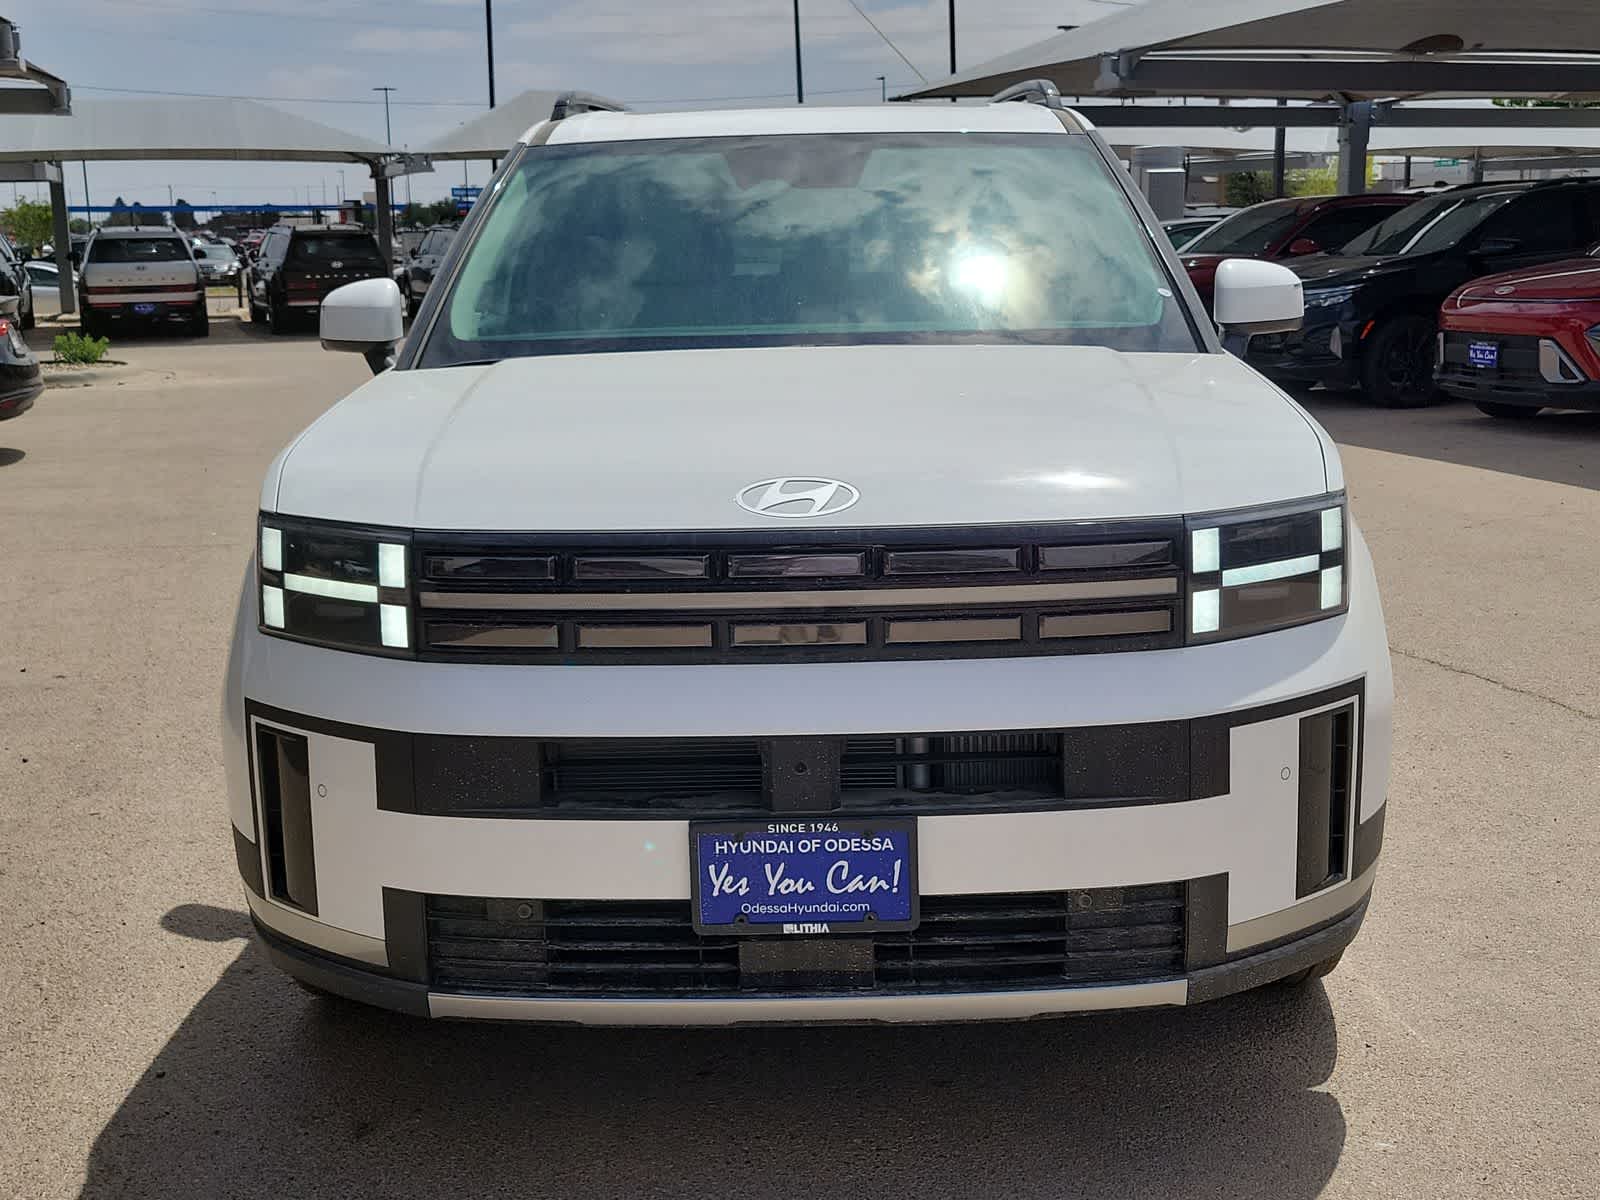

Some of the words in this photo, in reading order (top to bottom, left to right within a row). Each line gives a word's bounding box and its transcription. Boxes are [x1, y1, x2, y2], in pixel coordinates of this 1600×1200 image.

[767, 823, 806, 834] SINCE
[809, 822, 839, 833] 1946
[715, 840, 794, 855] HYUNDAI
[798, 839, 821, 853] OF
[824, 837, 894, 852] ODESSA
[708, 862, 750, 897] Yes
[764, 862, 816, 896] You
[826, 858, 901, 895] Can!
[741, 901, 870, 916] OdessaHyundai.com
[793, 923, 830, 934] LITHIA
